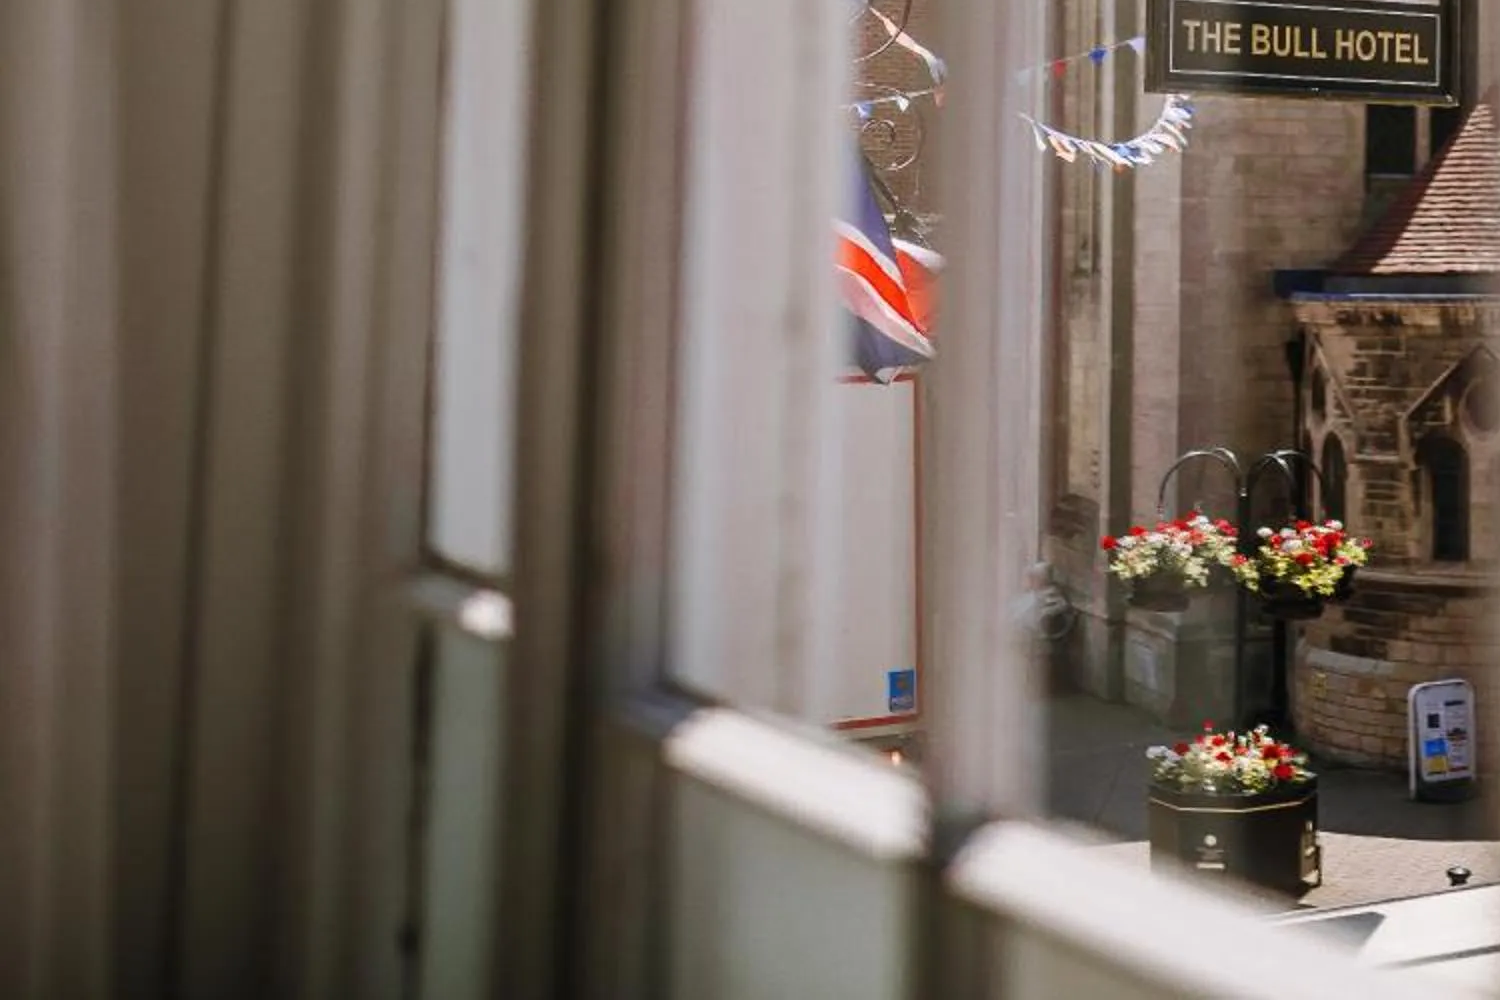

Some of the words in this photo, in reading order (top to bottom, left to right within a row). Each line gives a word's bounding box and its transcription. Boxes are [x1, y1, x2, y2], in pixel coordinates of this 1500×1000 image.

[1182, 19, 1242, 55] THE
[1251, 23, 1328, 60] BULL
[1335, 29, 1430, 65] HOTEL
